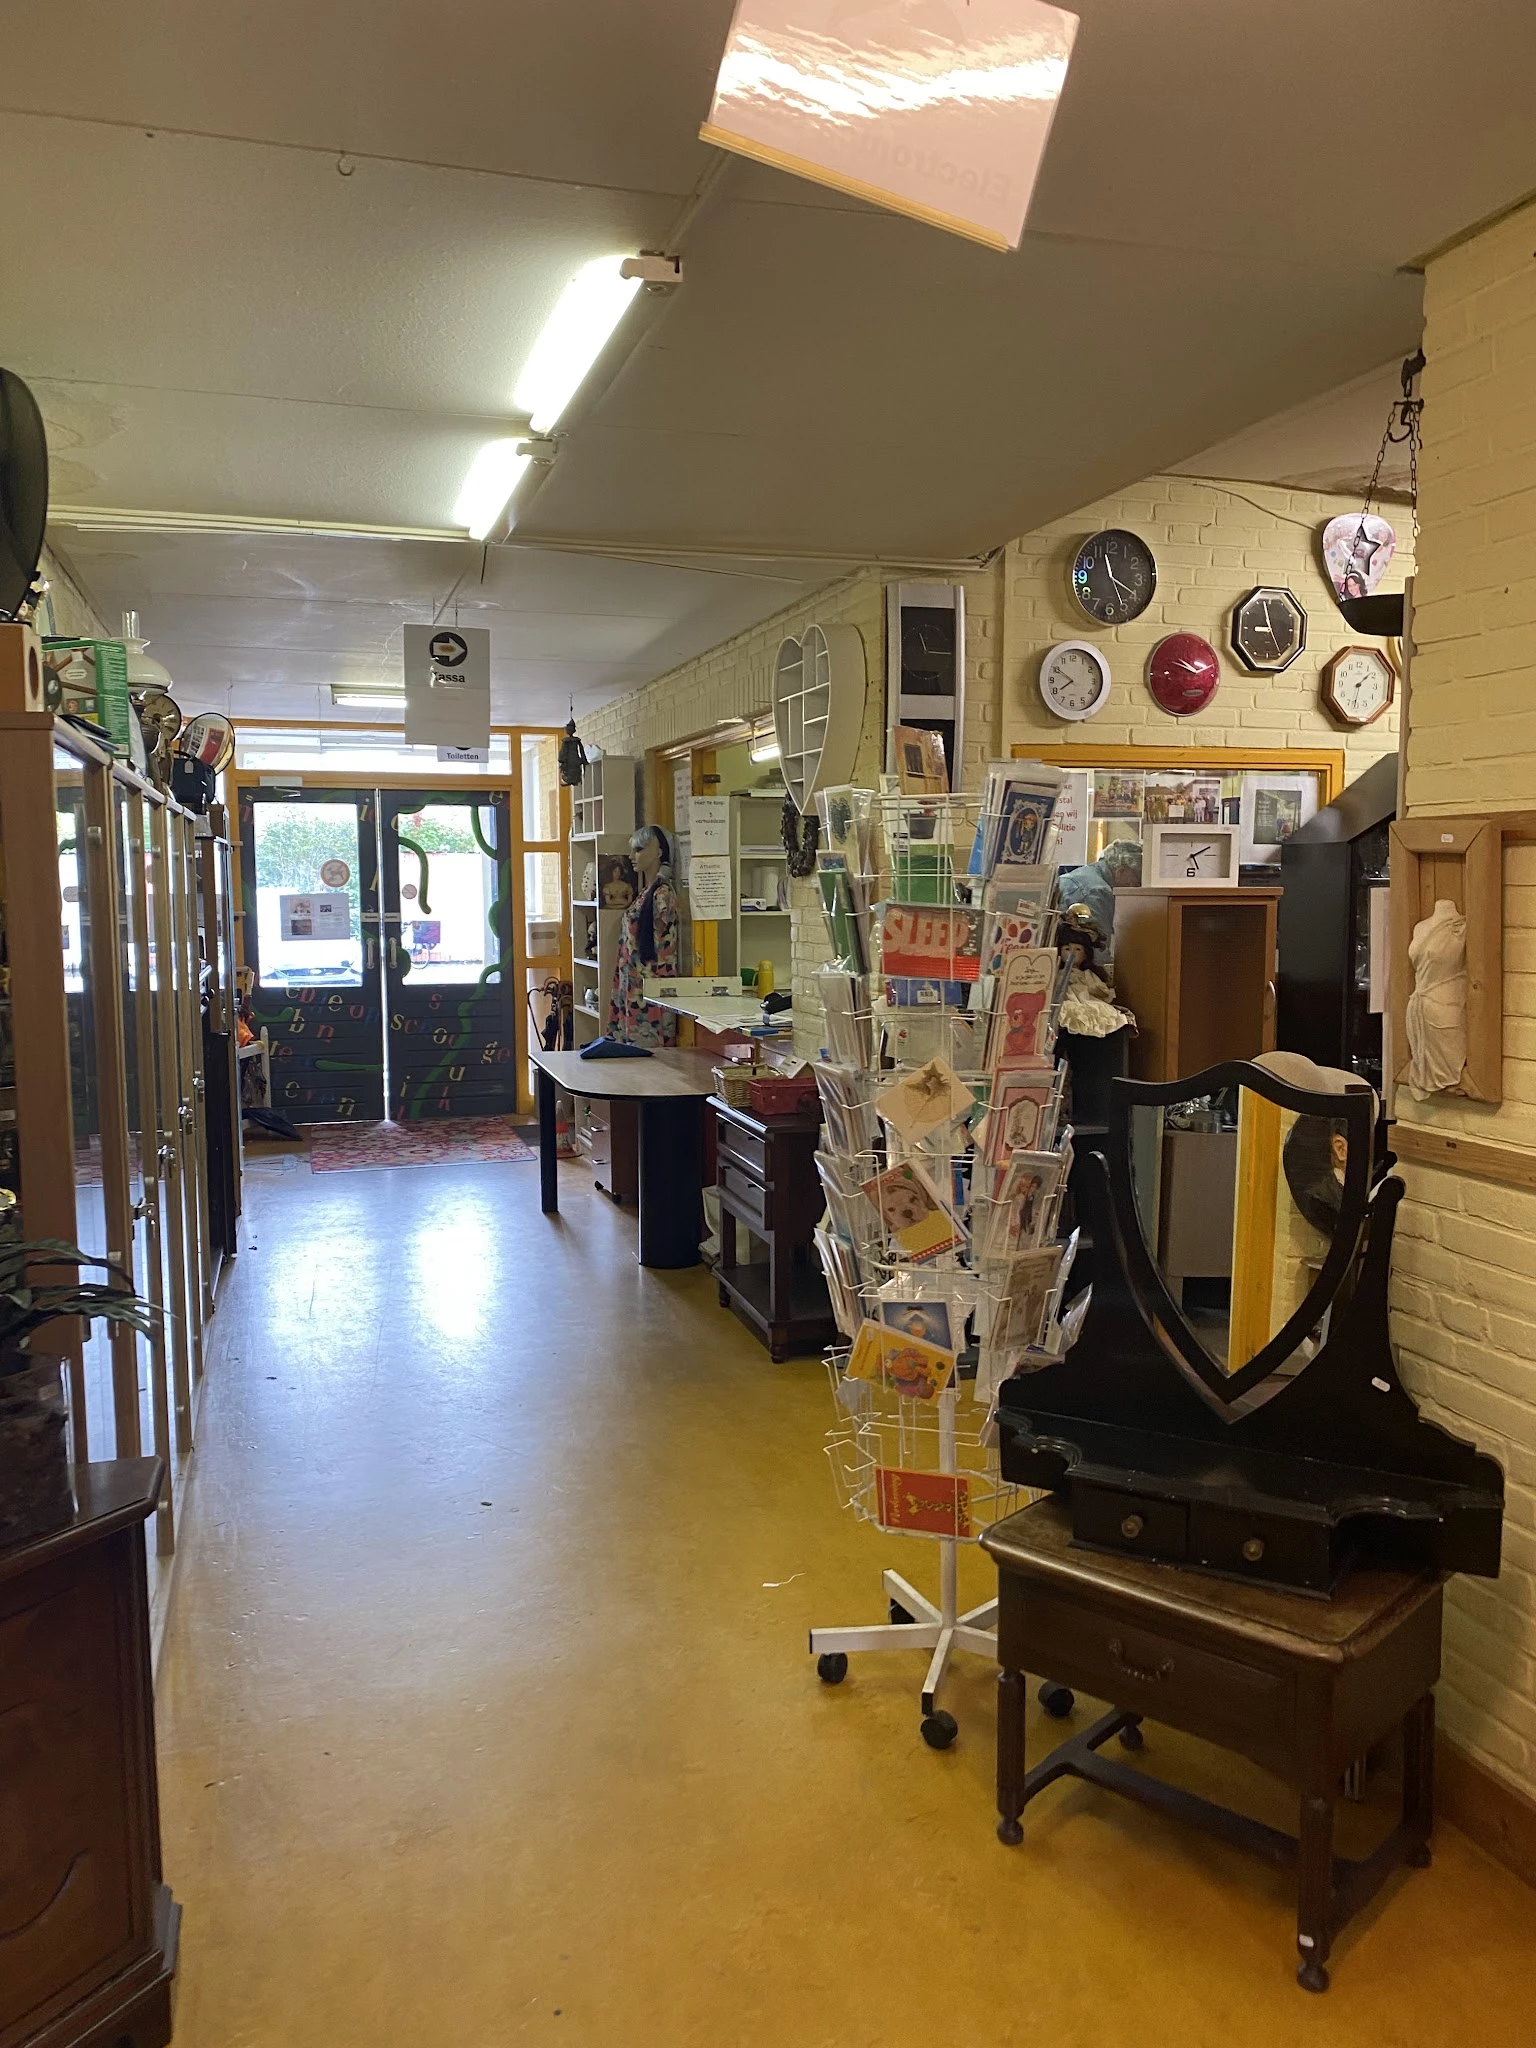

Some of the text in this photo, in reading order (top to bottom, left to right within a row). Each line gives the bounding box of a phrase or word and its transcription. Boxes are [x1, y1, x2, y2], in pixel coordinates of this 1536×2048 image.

[1106, 541, 1117, 554] 12
[1084, 556, 1094, 569] 10
[1130, 557, 1139, 570] 2
[1077, 570, 1088, 584] 9
[1134, 574, 1143, 586] 3
[1082, 587, 1091, 600] 8
[1092, 597, 1101, 610] 7
[1105, 603, 1114, 616] 6
[1088, 666, 1093, 674] 2
[1187, 868, 1195, 877] 6
